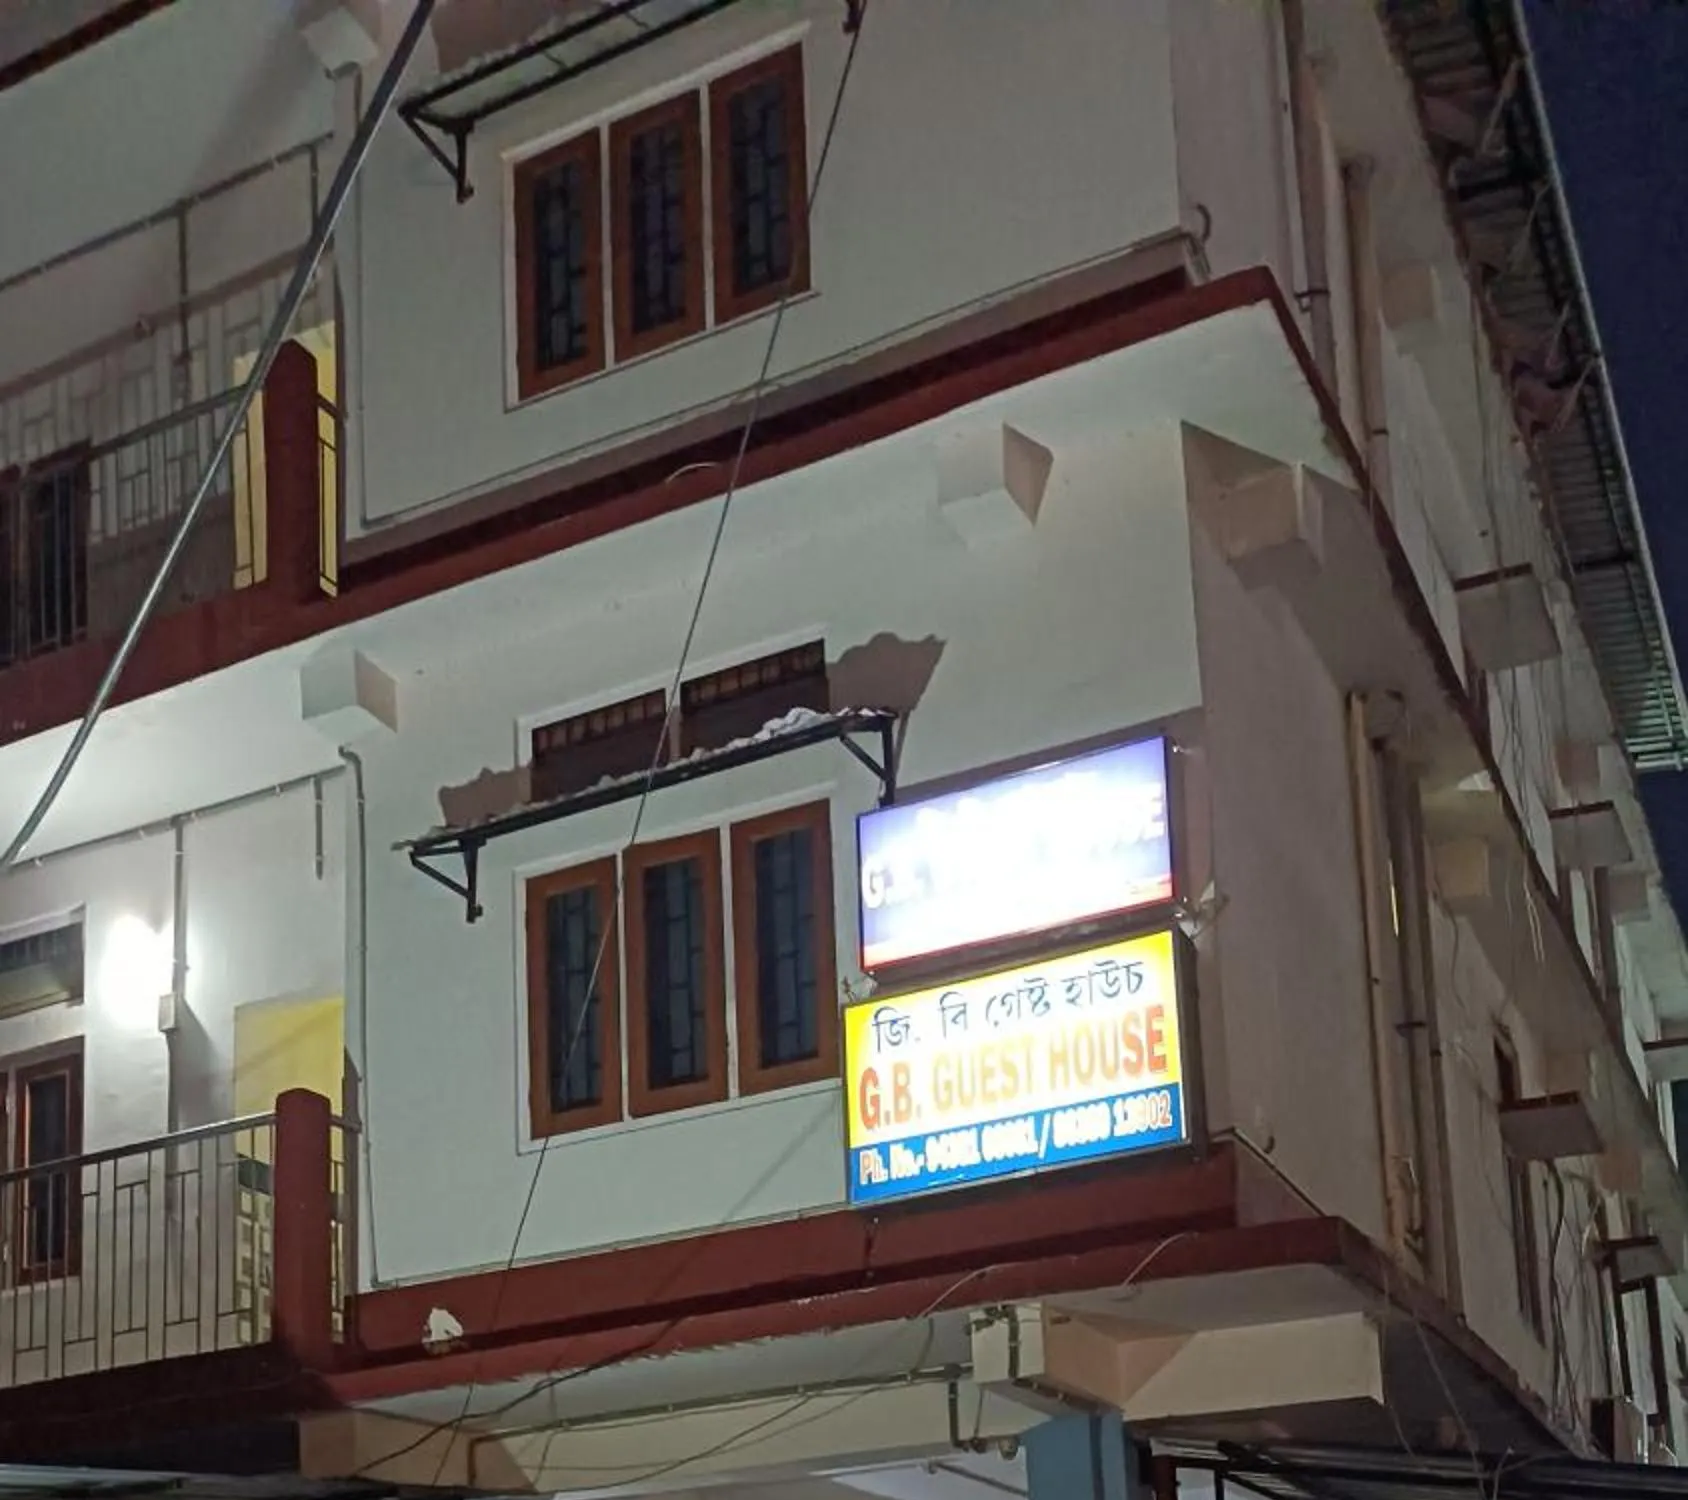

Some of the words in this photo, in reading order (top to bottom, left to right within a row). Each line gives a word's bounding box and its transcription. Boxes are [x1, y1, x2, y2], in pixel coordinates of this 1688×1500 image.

[859, 1060, 922, 1130] G.B.
[931, 1032, 1037, 1112] GUEST
[1049, 1004, 1169, 1090] HOUSE
